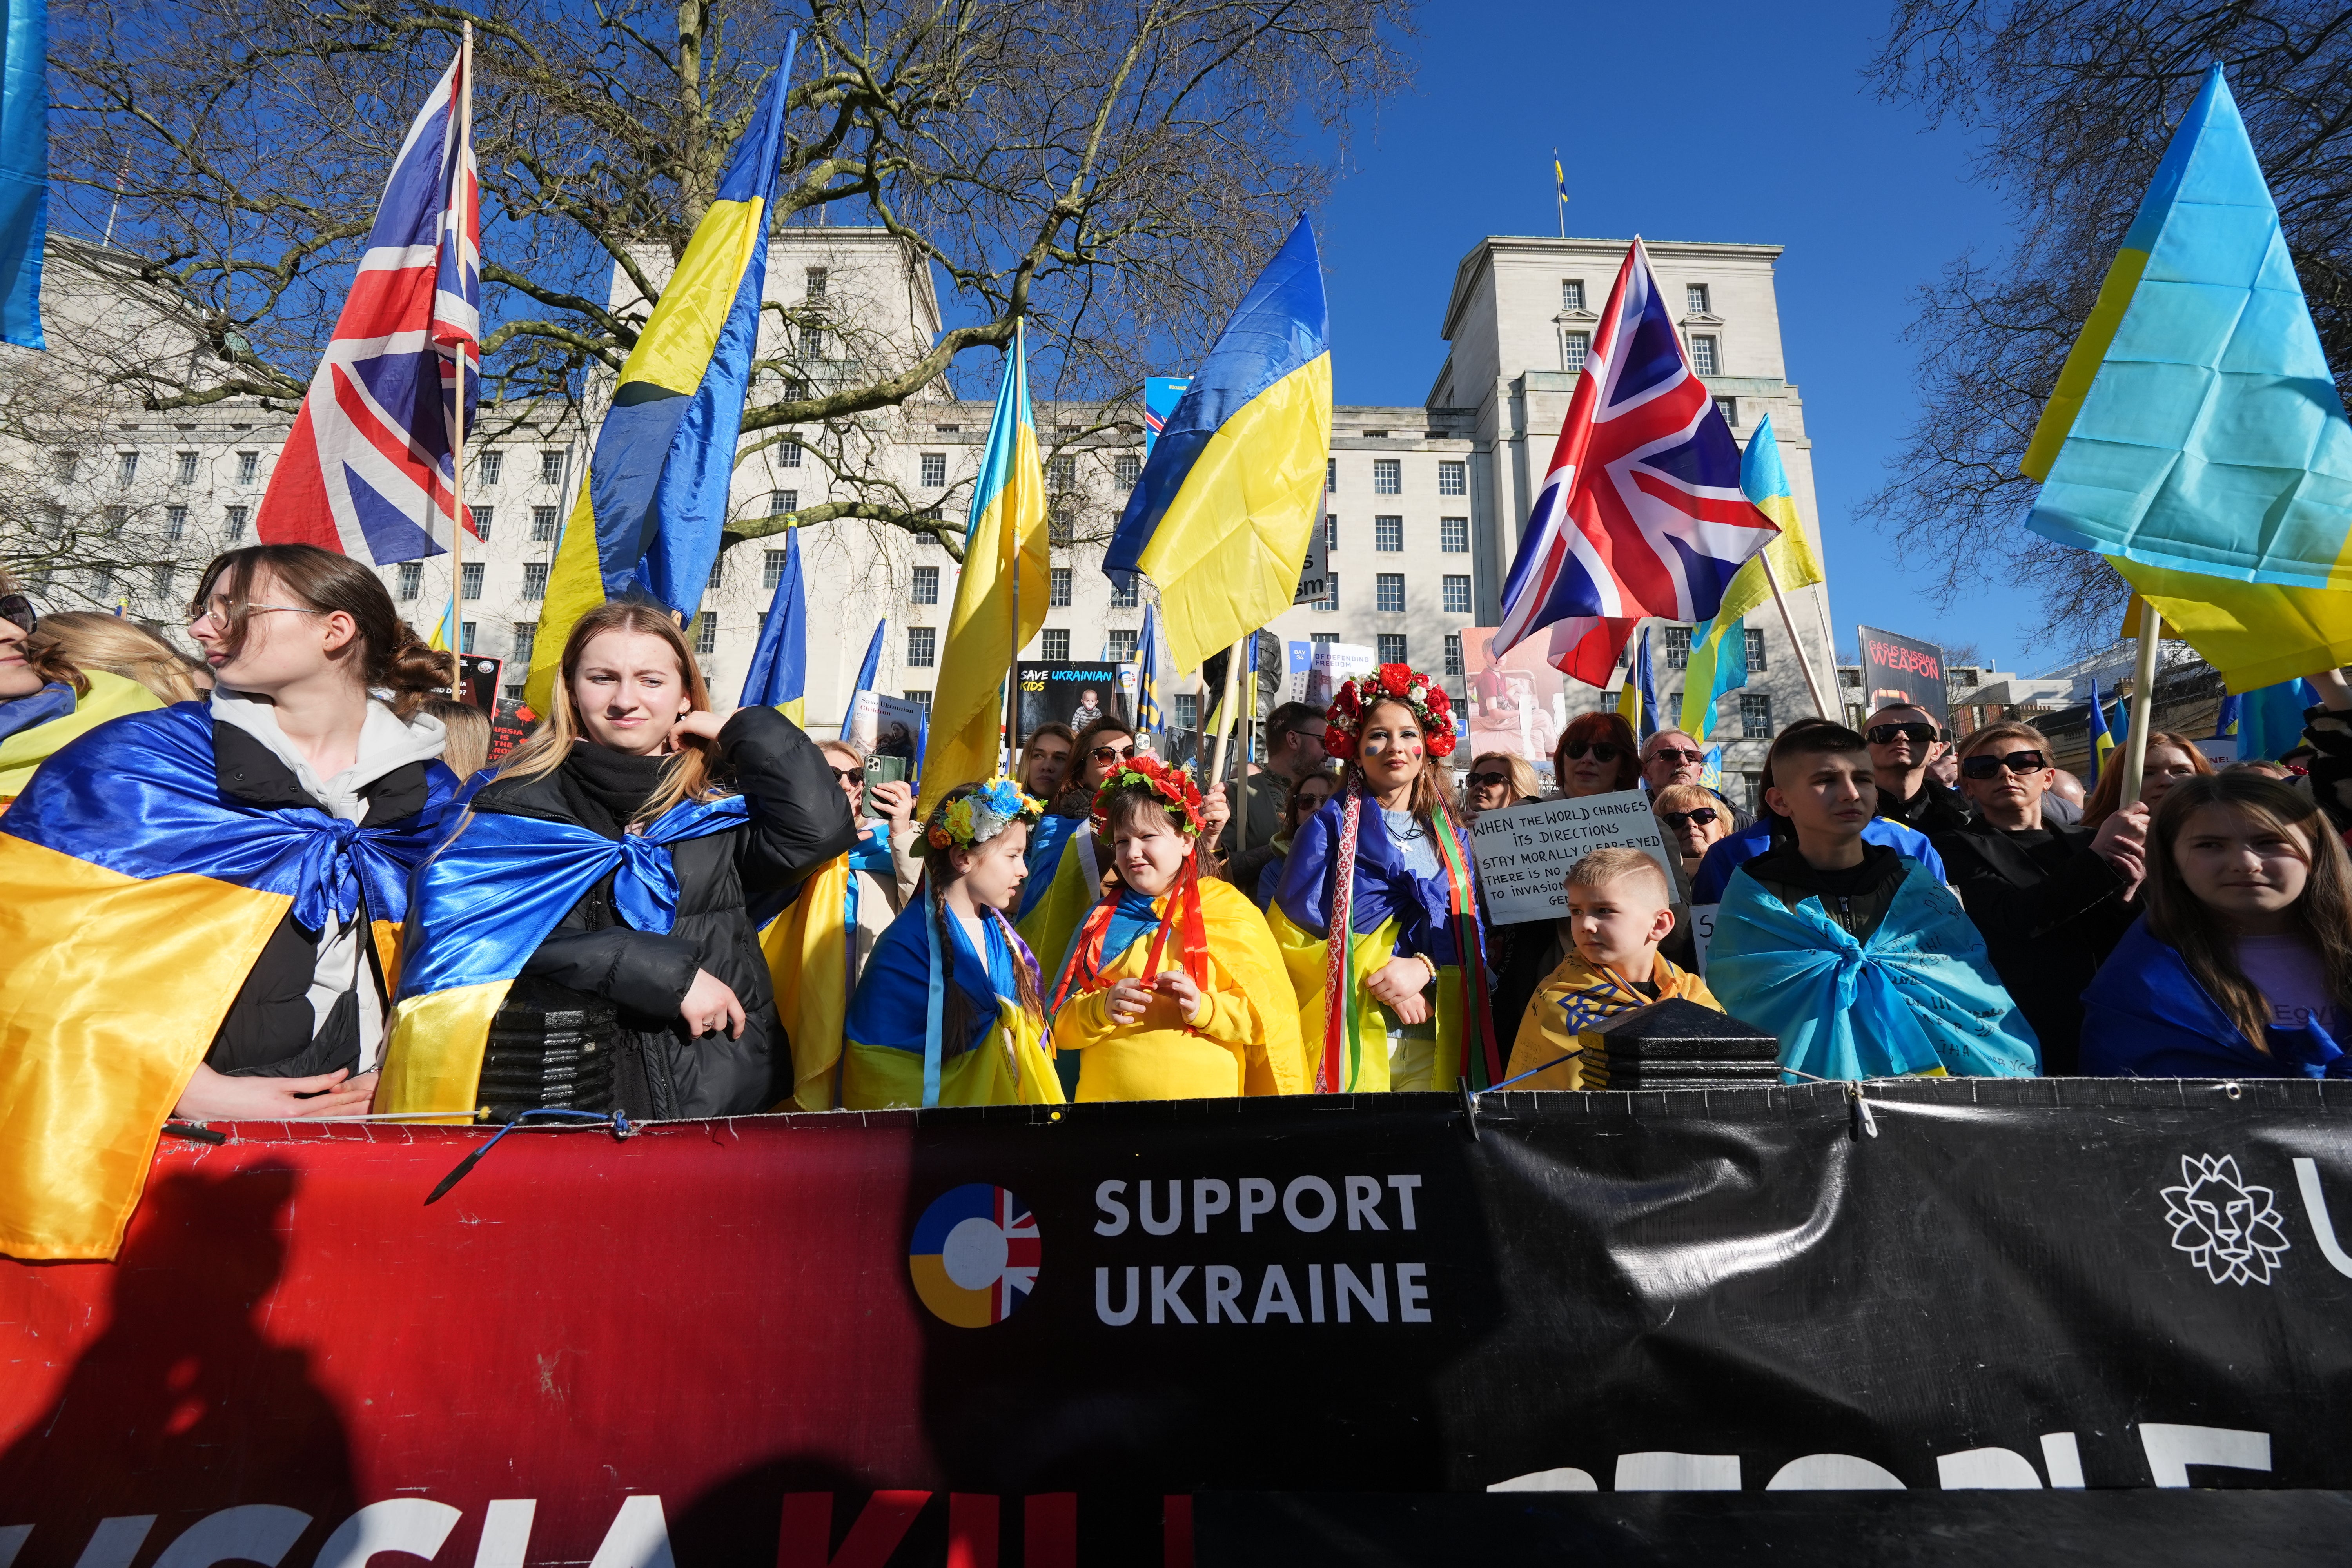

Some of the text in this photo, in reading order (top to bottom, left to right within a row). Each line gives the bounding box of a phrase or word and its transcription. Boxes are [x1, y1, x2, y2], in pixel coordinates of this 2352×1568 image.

[1327, 654, 1369, 662] DEFENDING
[1869, 640, 1936, 665] GAS IS RUSSIAN
[1870, 648, 1939, 681] WEAPON
[1020, 670, 1112, 682] SAVE UKRAINIAN
[1020, 681, 1045, 691] KIDS
[860, 705, 891, 716] Children
[861, 697, 914, 714] Save Ukrainian
[494, 726, 523, 736] USSIA
[1473, 801, 1648, 837] WHEN THE WORLD CHANGES
[1483, 855, 1514, 870] STAY
[1521, 846, 1577, 864] MORALLY
[1485, 871, 1525, 886] THERE
[1545, 867, 1560, 878] NO
[1490, 890, 1504, 900] TO
[1093, 1175, 1422, 1236] SUPPORT
[1096, 1263, 1432, 1326] UKRAINE
